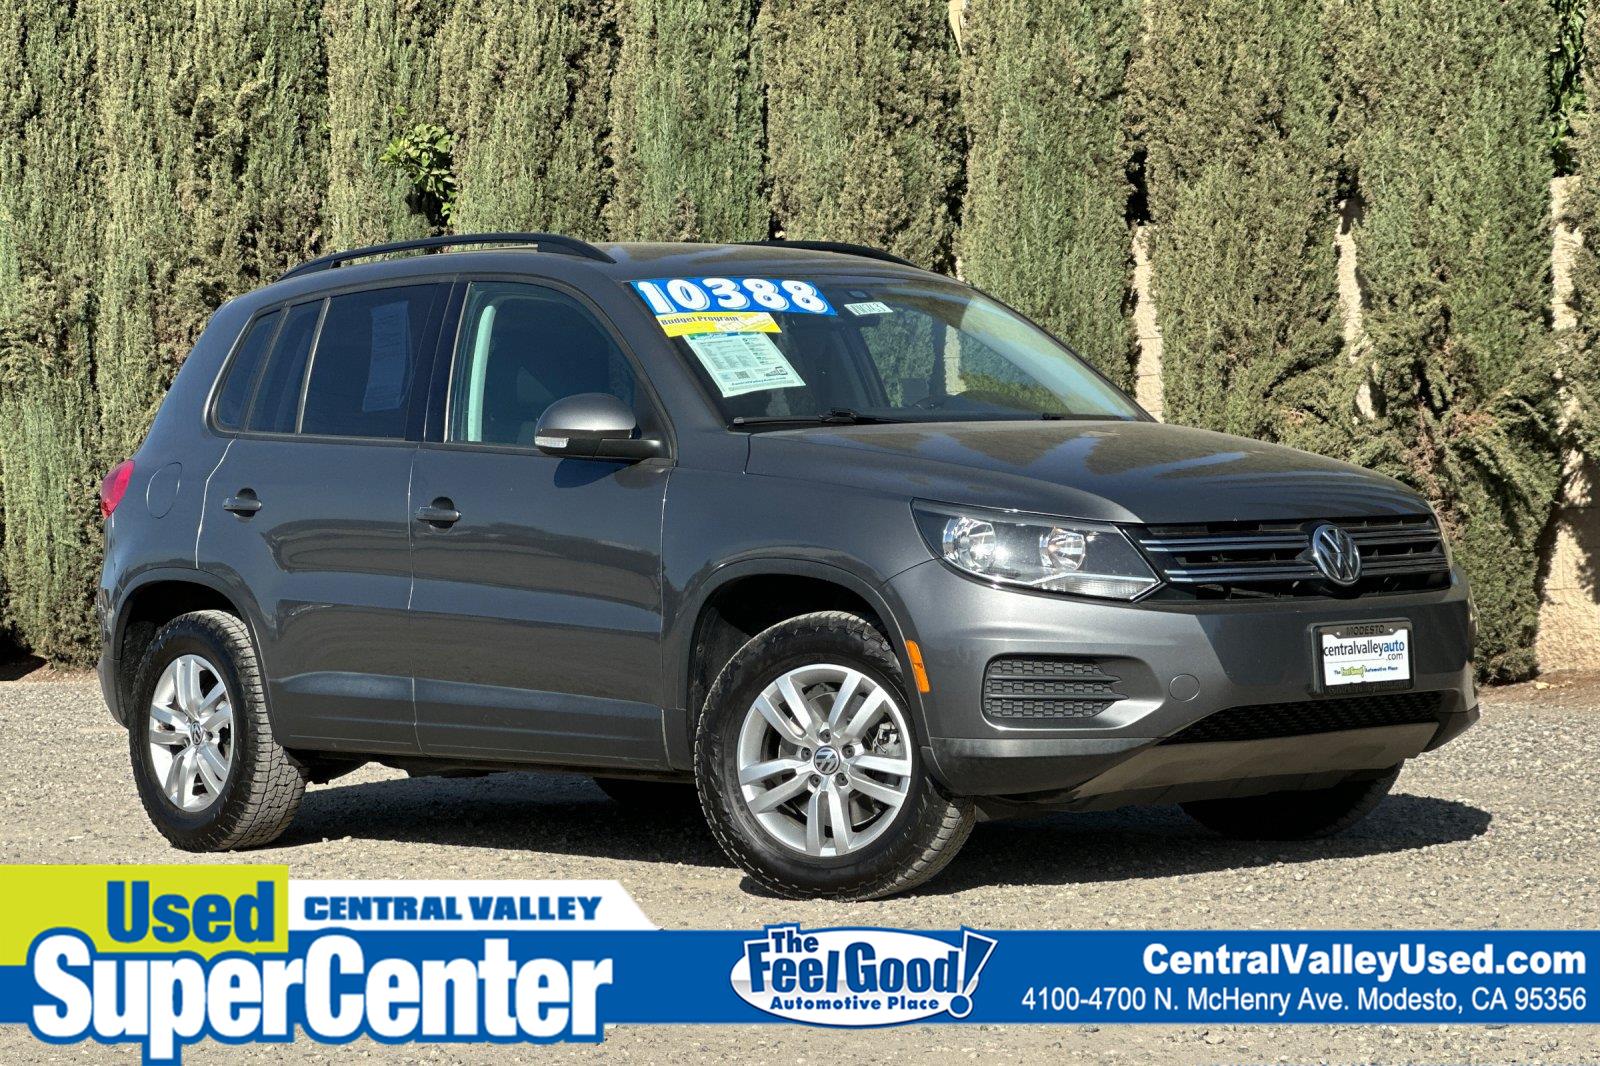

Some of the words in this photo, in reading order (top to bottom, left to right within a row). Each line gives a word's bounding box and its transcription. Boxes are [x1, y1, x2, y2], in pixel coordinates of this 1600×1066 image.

[637, 278, 829, 313] 10388
[661, 317, 697, 326] Budget
[698, 316, 740, 324] Program
[1346, 624, 1385, 636] MODESTO
[1324, 640, 1405, 657] centralvalleyauto
[1386, 652, 1404, 661] .com
